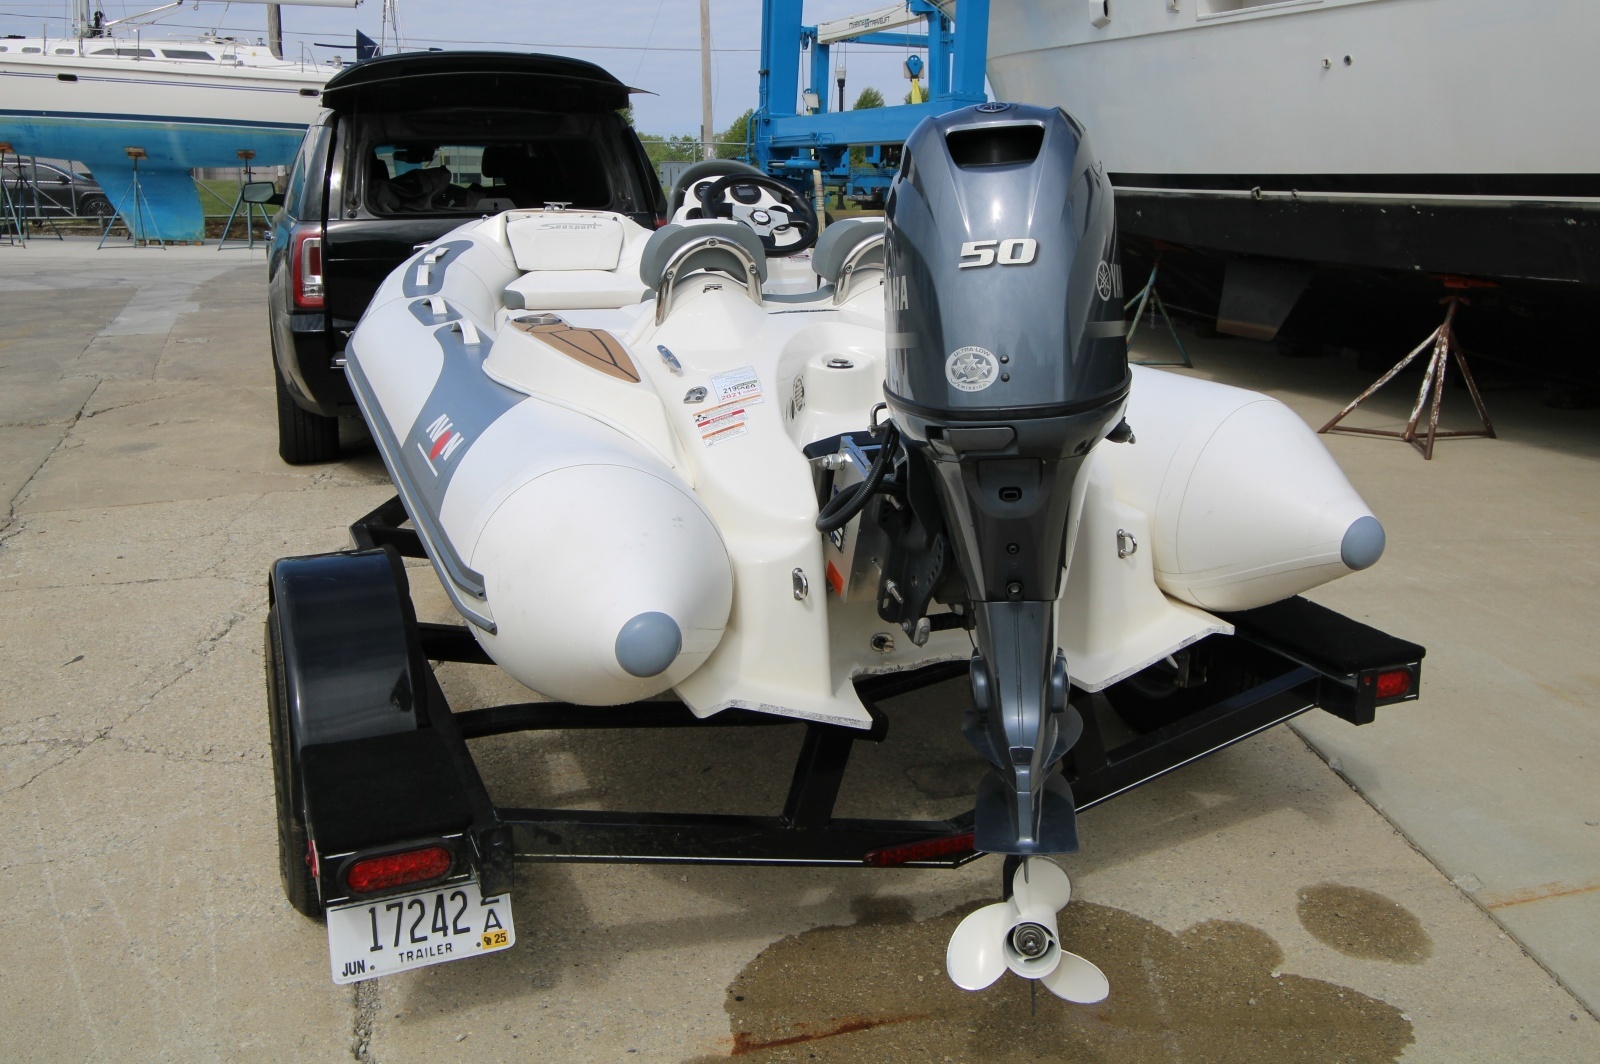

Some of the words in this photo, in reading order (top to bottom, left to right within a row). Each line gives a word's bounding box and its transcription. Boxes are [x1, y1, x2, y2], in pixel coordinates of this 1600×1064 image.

[538, 222, 602, 231] Seasport
[958, 238, 1037, 269] 50
[721, 391, 742, 401] 2021
[368, 891, 471, 953] 17242
[494, 932, 507, 944] 25
[398, 942, 453, 963] TRAILER
[342, 959, 366, 977] JUN
